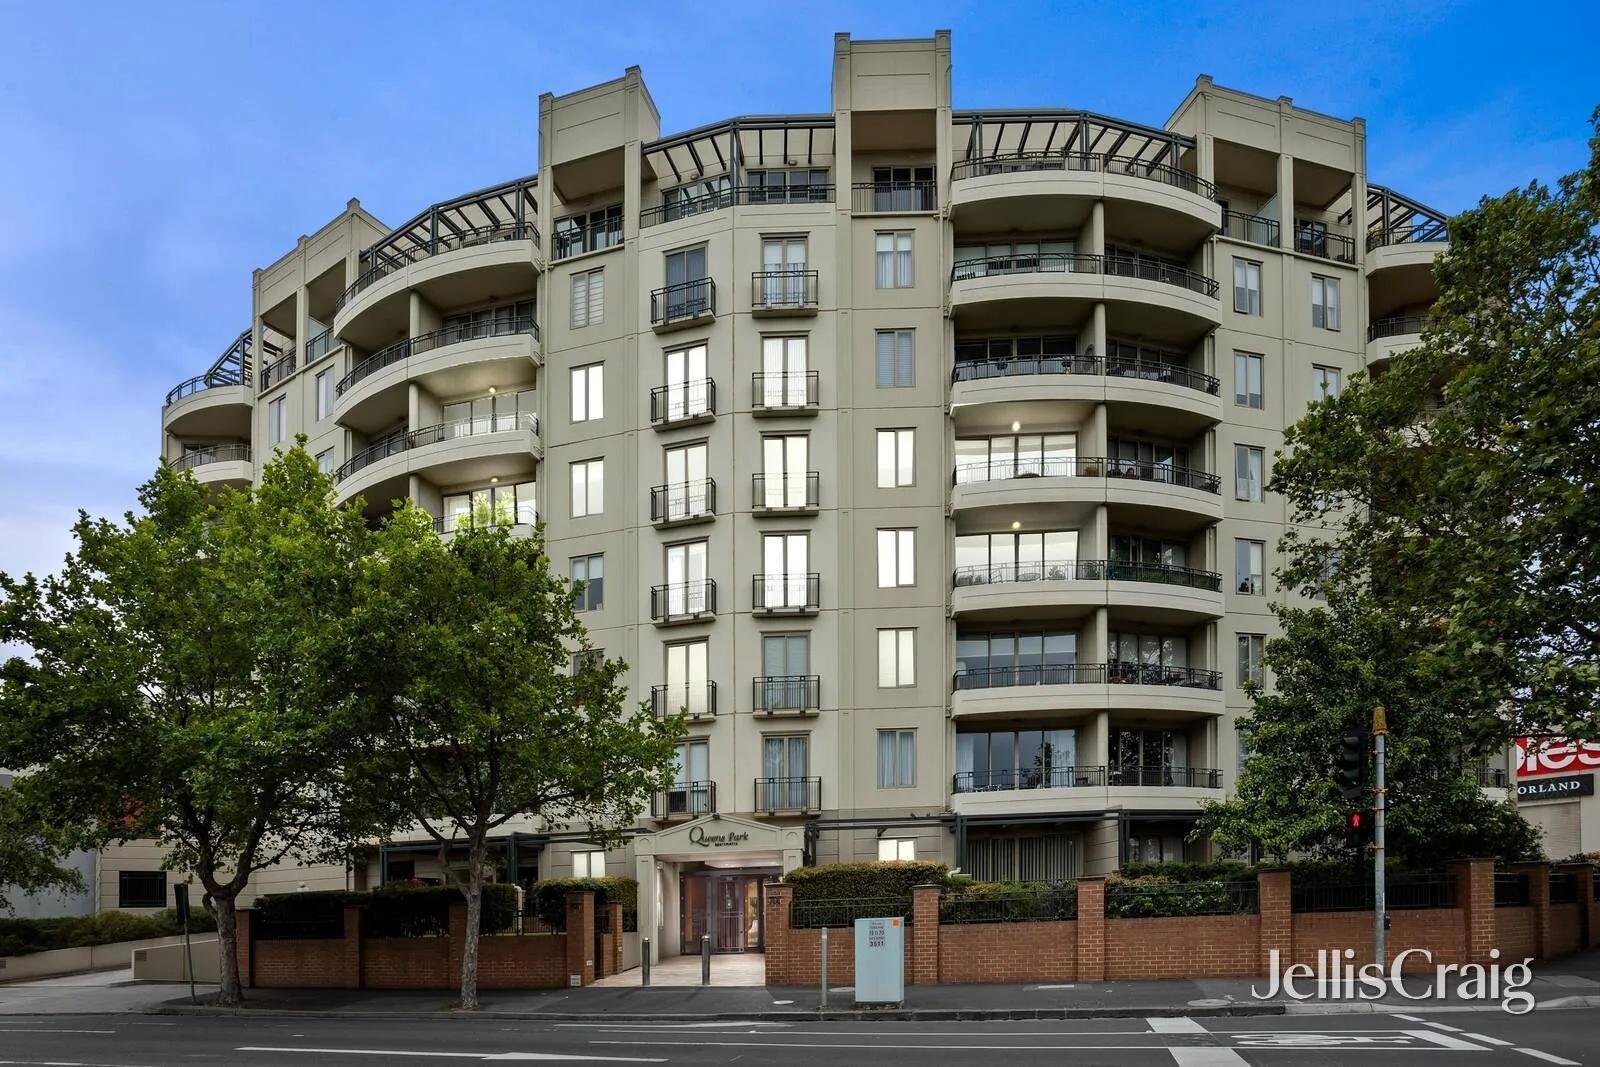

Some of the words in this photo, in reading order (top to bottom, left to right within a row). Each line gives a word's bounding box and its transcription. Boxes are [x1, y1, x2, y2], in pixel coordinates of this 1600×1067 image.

[1516, 736, 1600, 772] les
[1517, 780, 1581, 795] ORLAND
[689, 827, 726, 847] Queens
[728, 831, 749, 842] Park
